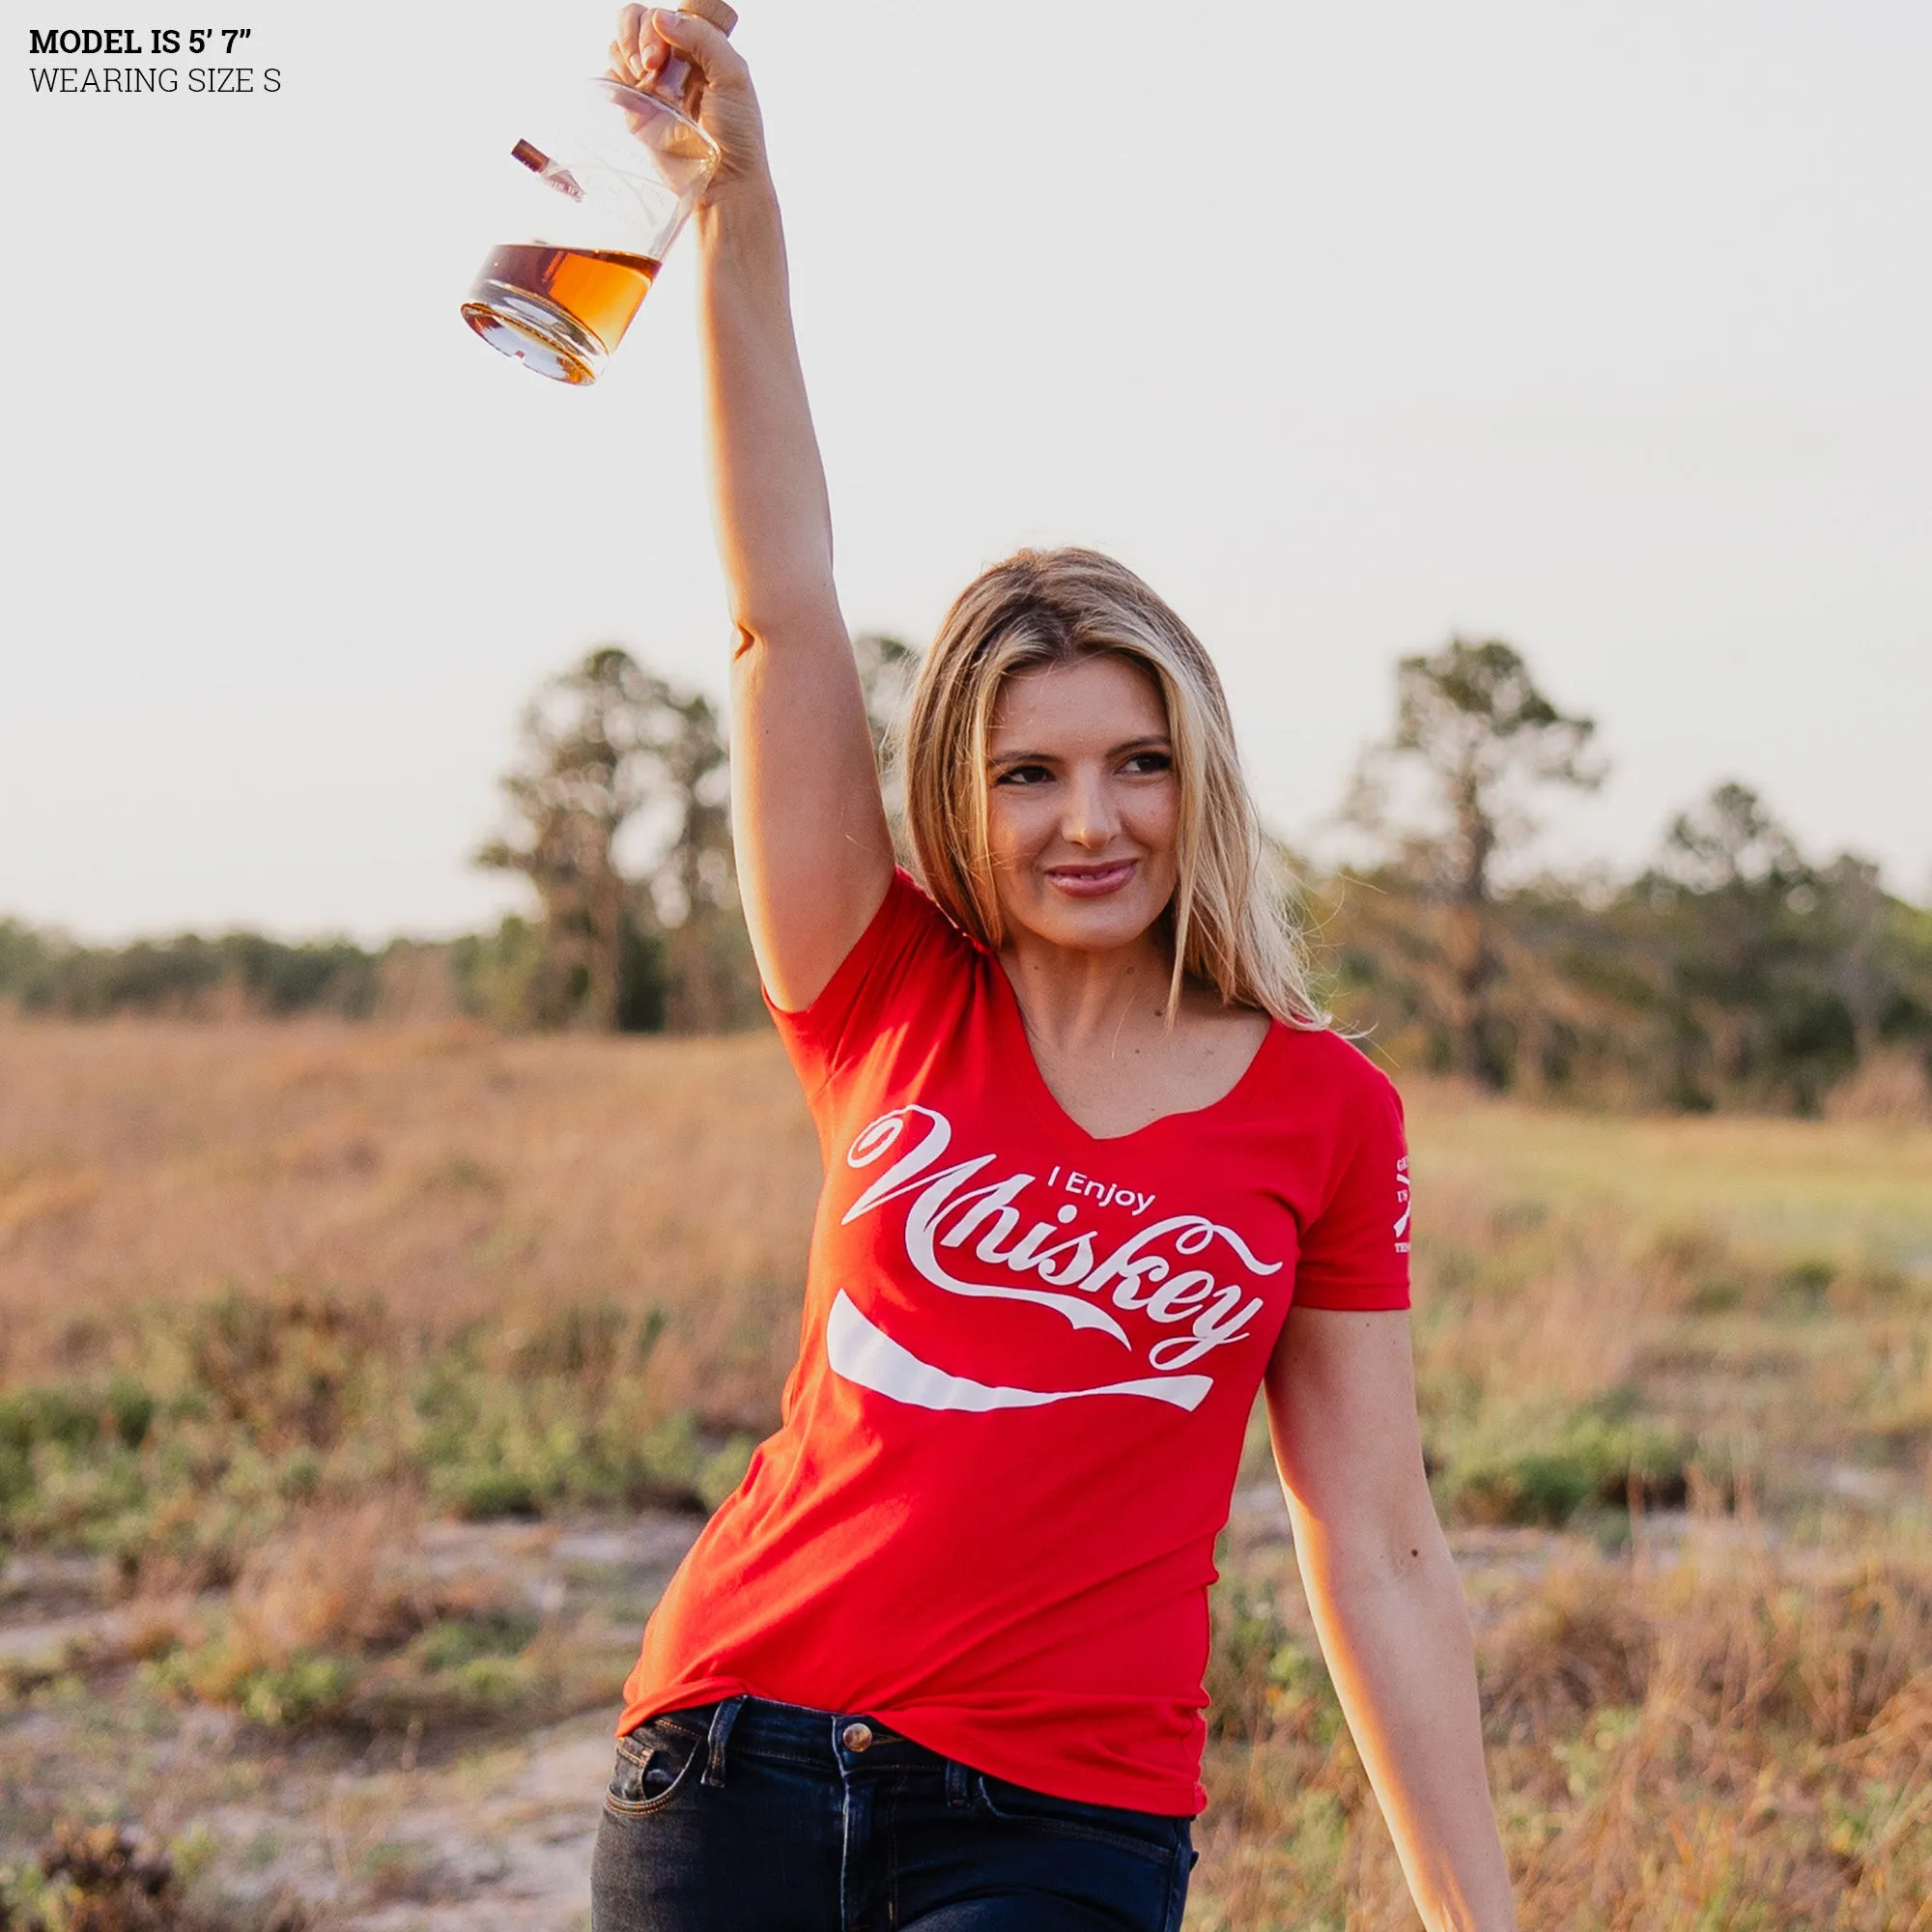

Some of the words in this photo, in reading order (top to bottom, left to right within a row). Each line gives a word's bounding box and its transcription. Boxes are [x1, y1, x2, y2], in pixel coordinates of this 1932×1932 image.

[840, 1103, 1283, 1371] Whiskey
[1047, 1165, 1061, 1187] I
[1065, 1171, 1156, 1216] Enjoy
